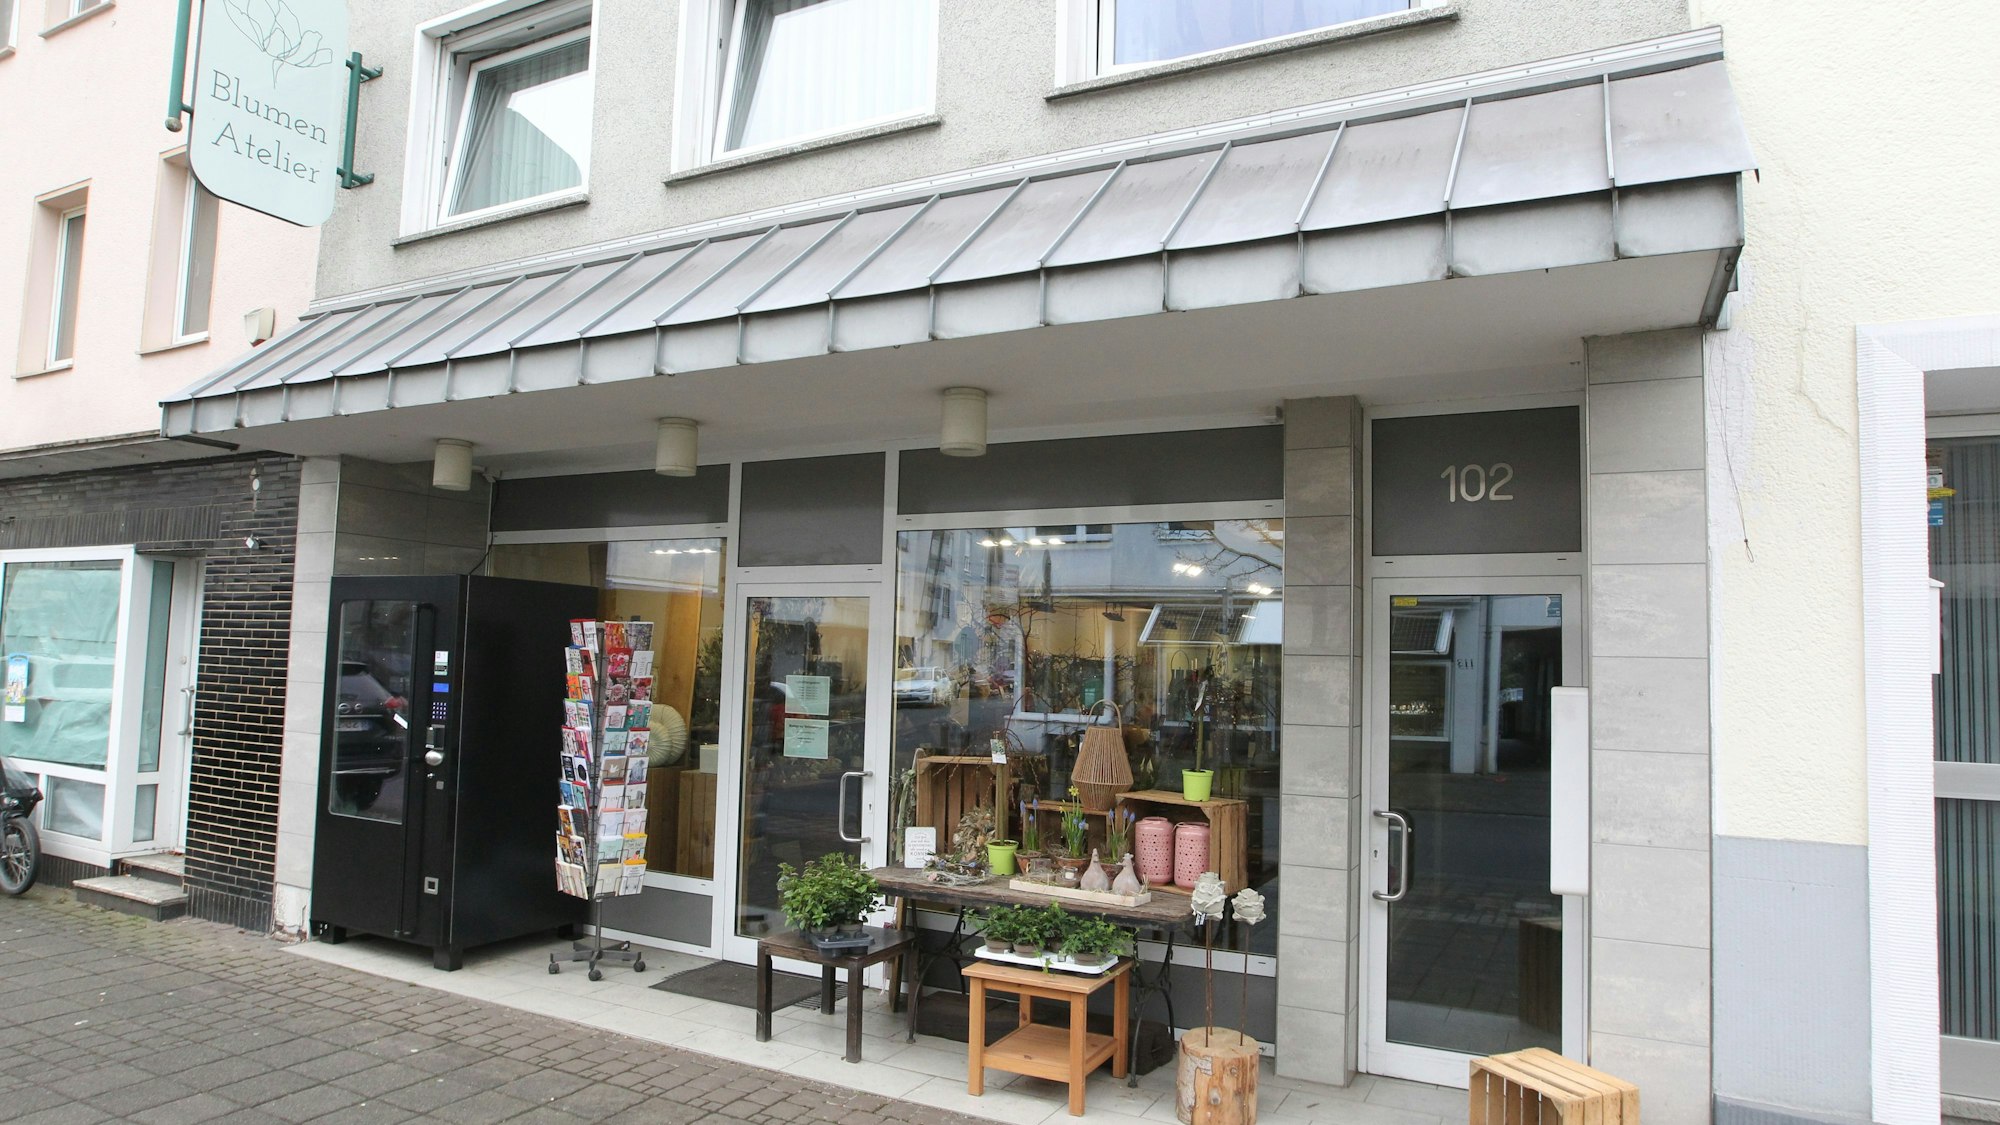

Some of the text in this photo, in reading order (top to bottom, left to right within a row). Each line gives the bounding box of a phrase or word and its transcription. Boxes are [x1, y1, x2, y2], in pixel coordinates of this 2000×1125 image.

[210, 69, 328, 145] Blumen
[211, 121, 320, 184] Atelier
[1440, 462, 1514, 503] 102
